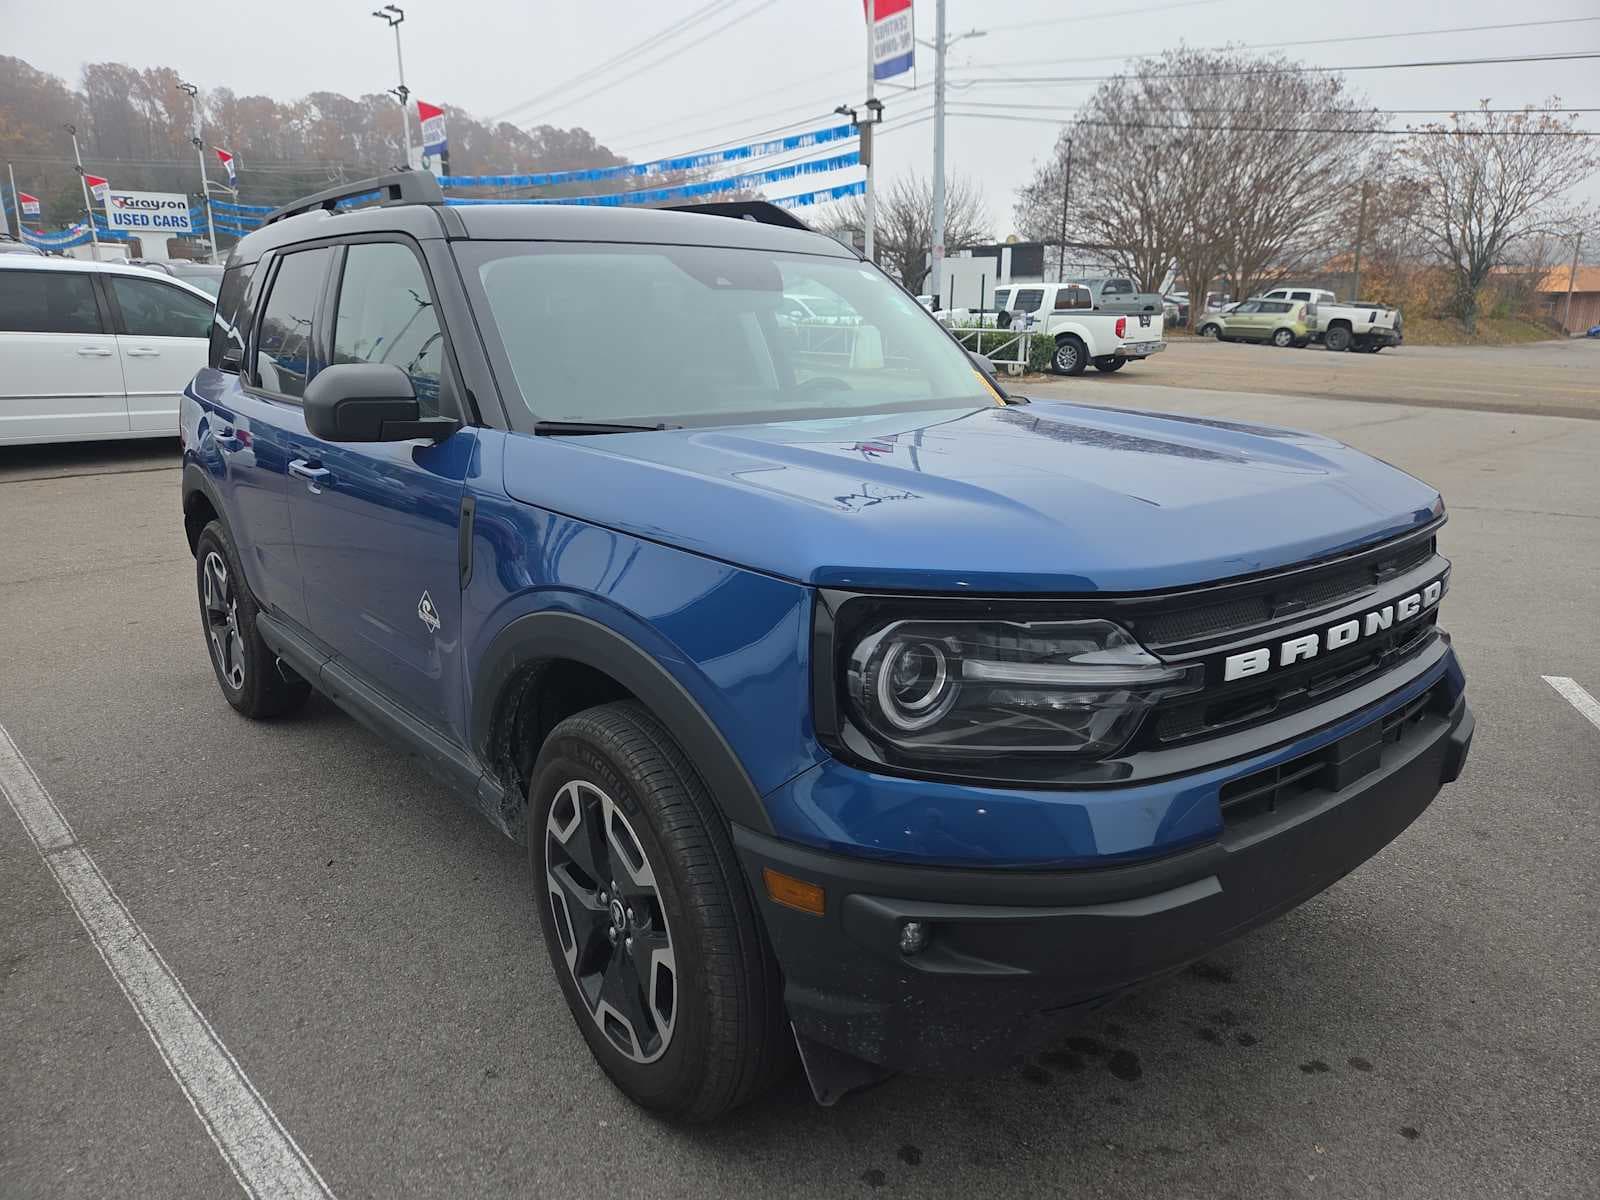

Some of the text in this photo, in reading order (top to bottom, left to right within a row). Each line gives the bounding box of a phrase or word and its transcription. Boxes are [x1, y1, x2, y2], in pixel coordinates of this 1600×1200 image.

[123, 197, 187, 210] Grayson
[113, 213, 189, 228] USED CARS
[1224, 580, 1442, 682] BRONCO
